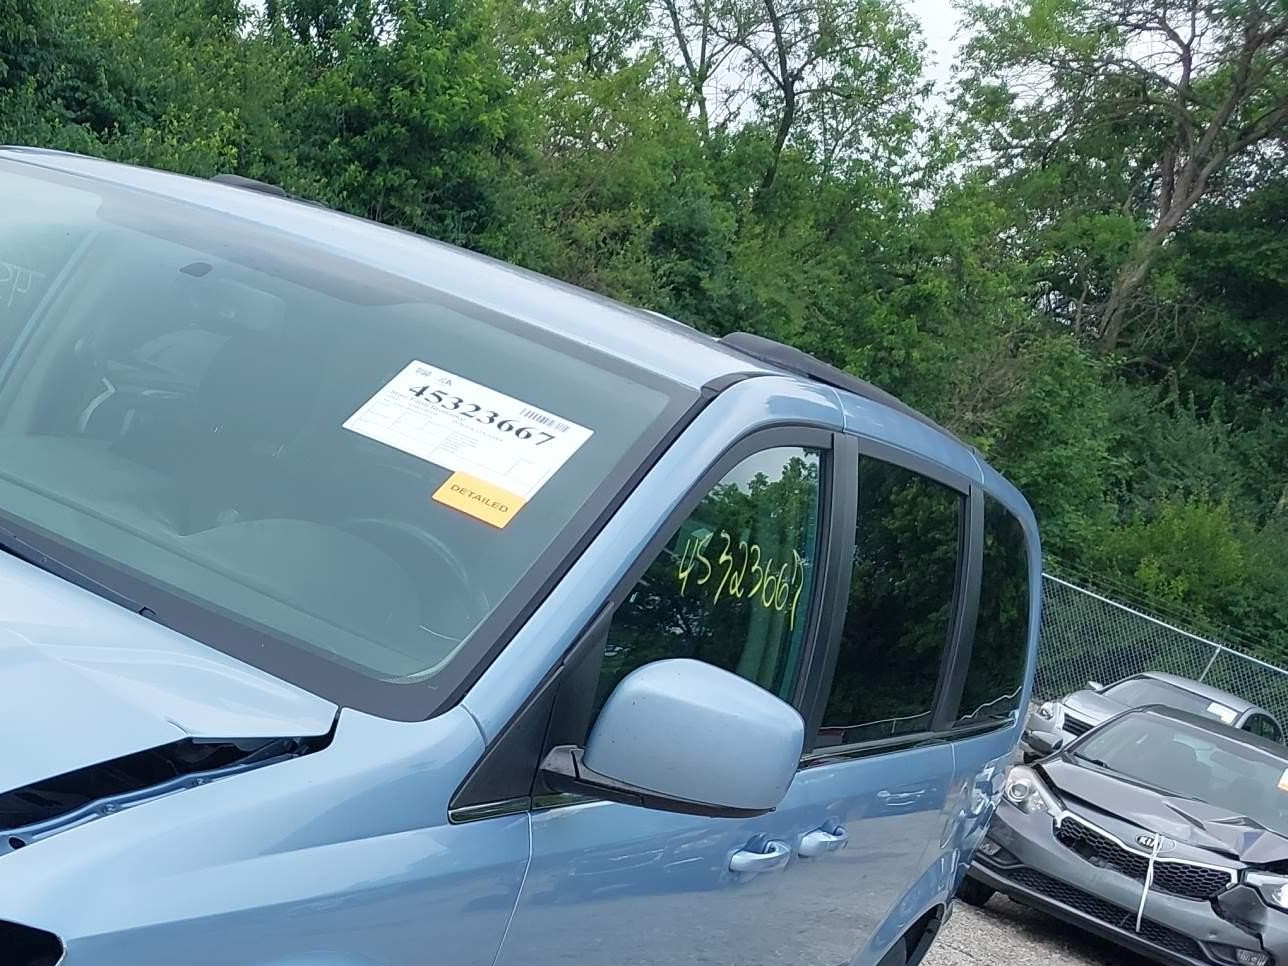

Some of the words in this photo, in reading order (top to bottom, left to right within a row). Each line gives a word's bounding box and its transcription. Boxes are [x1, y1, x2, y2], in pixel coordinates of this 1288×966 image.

[408, 384, 556, 446] 45323667
[450, 483, 509, 513] DETAILED
[678, 529, 805, 631] 45323667
